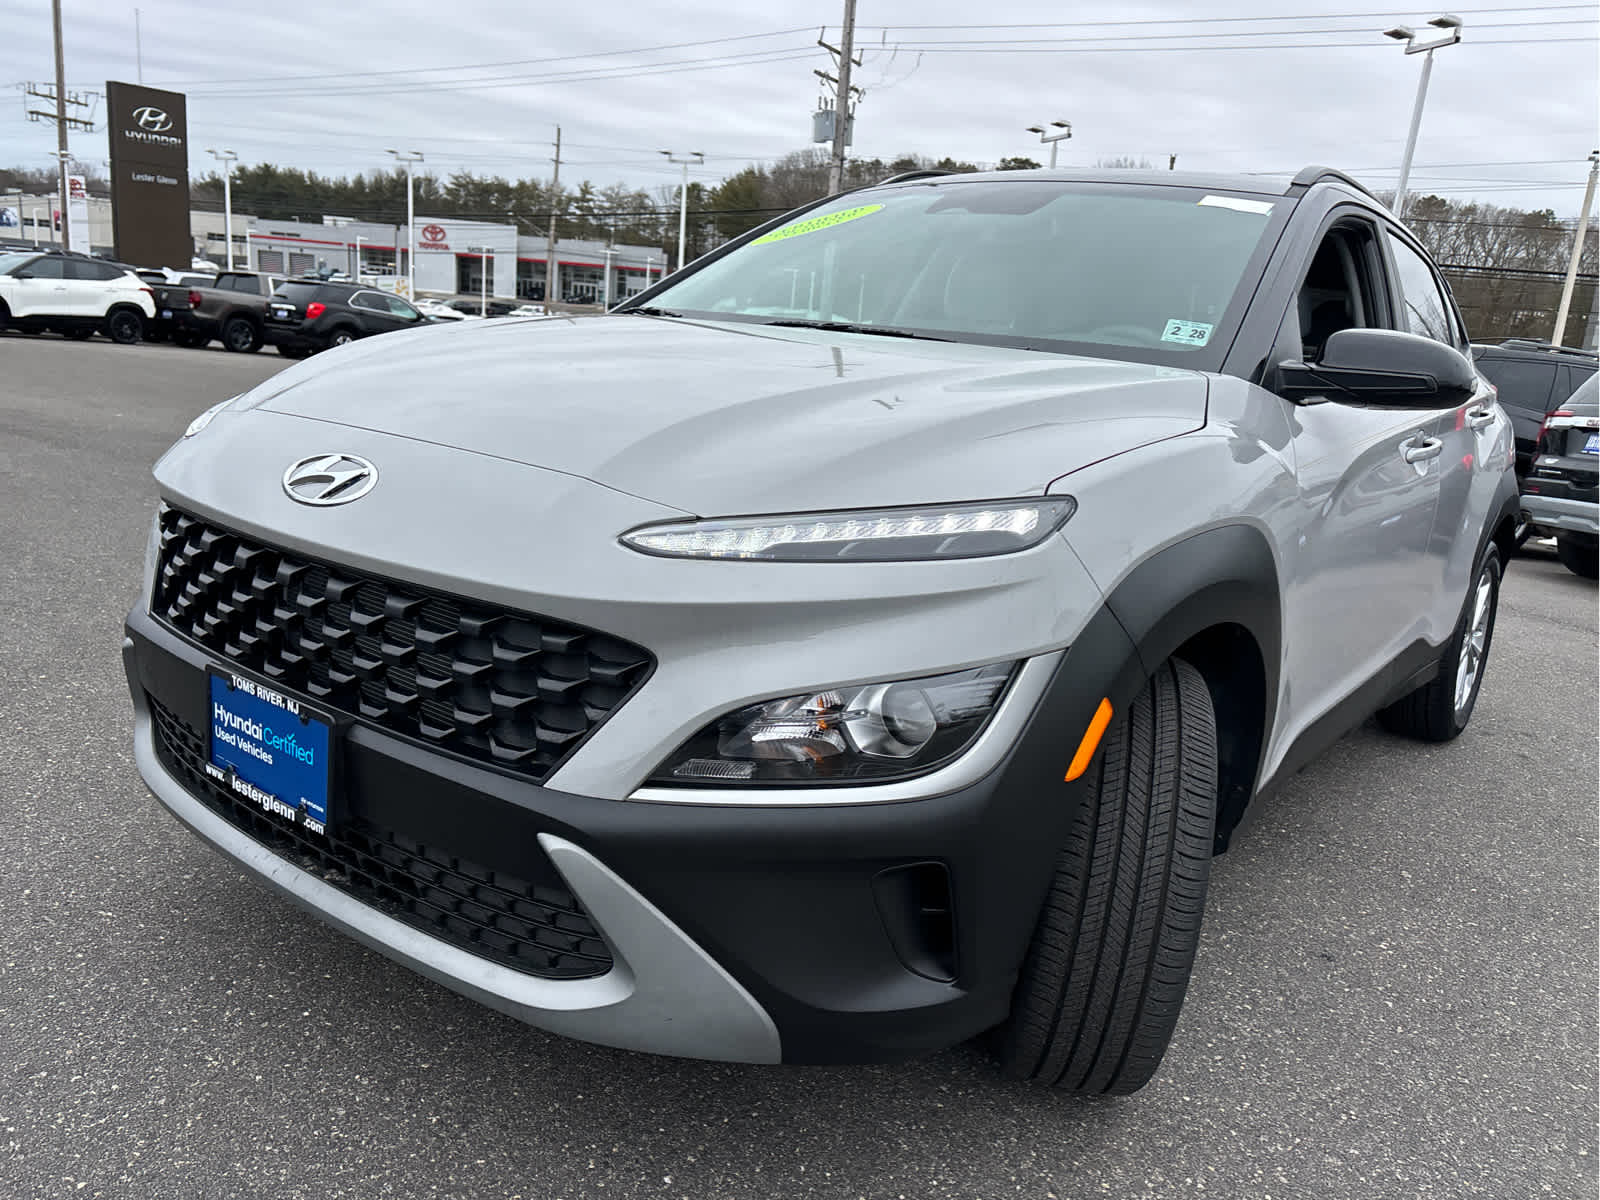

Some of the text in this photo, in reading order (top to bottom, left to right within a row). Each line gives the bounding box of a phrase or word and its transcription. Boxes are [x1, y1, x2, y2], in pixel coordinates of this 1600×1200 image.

[125, 130, 182, 147] HYUNDAI
[132, 172, 155, 182] Lester
[418, 242, 449, 251] TOYOTA
[1170, 326, 1206, 340] 2 28
[231, 675, 300, 715] TOMS RIVER, NJ
[214, 701, 263, 741] Hyundai
[263, 727, 315, 766] Certified
[214, 724, 236, 746] Used
[237, 735, 273, 765] Vehicles
[231, 775, 296, 822] lesterglenn
